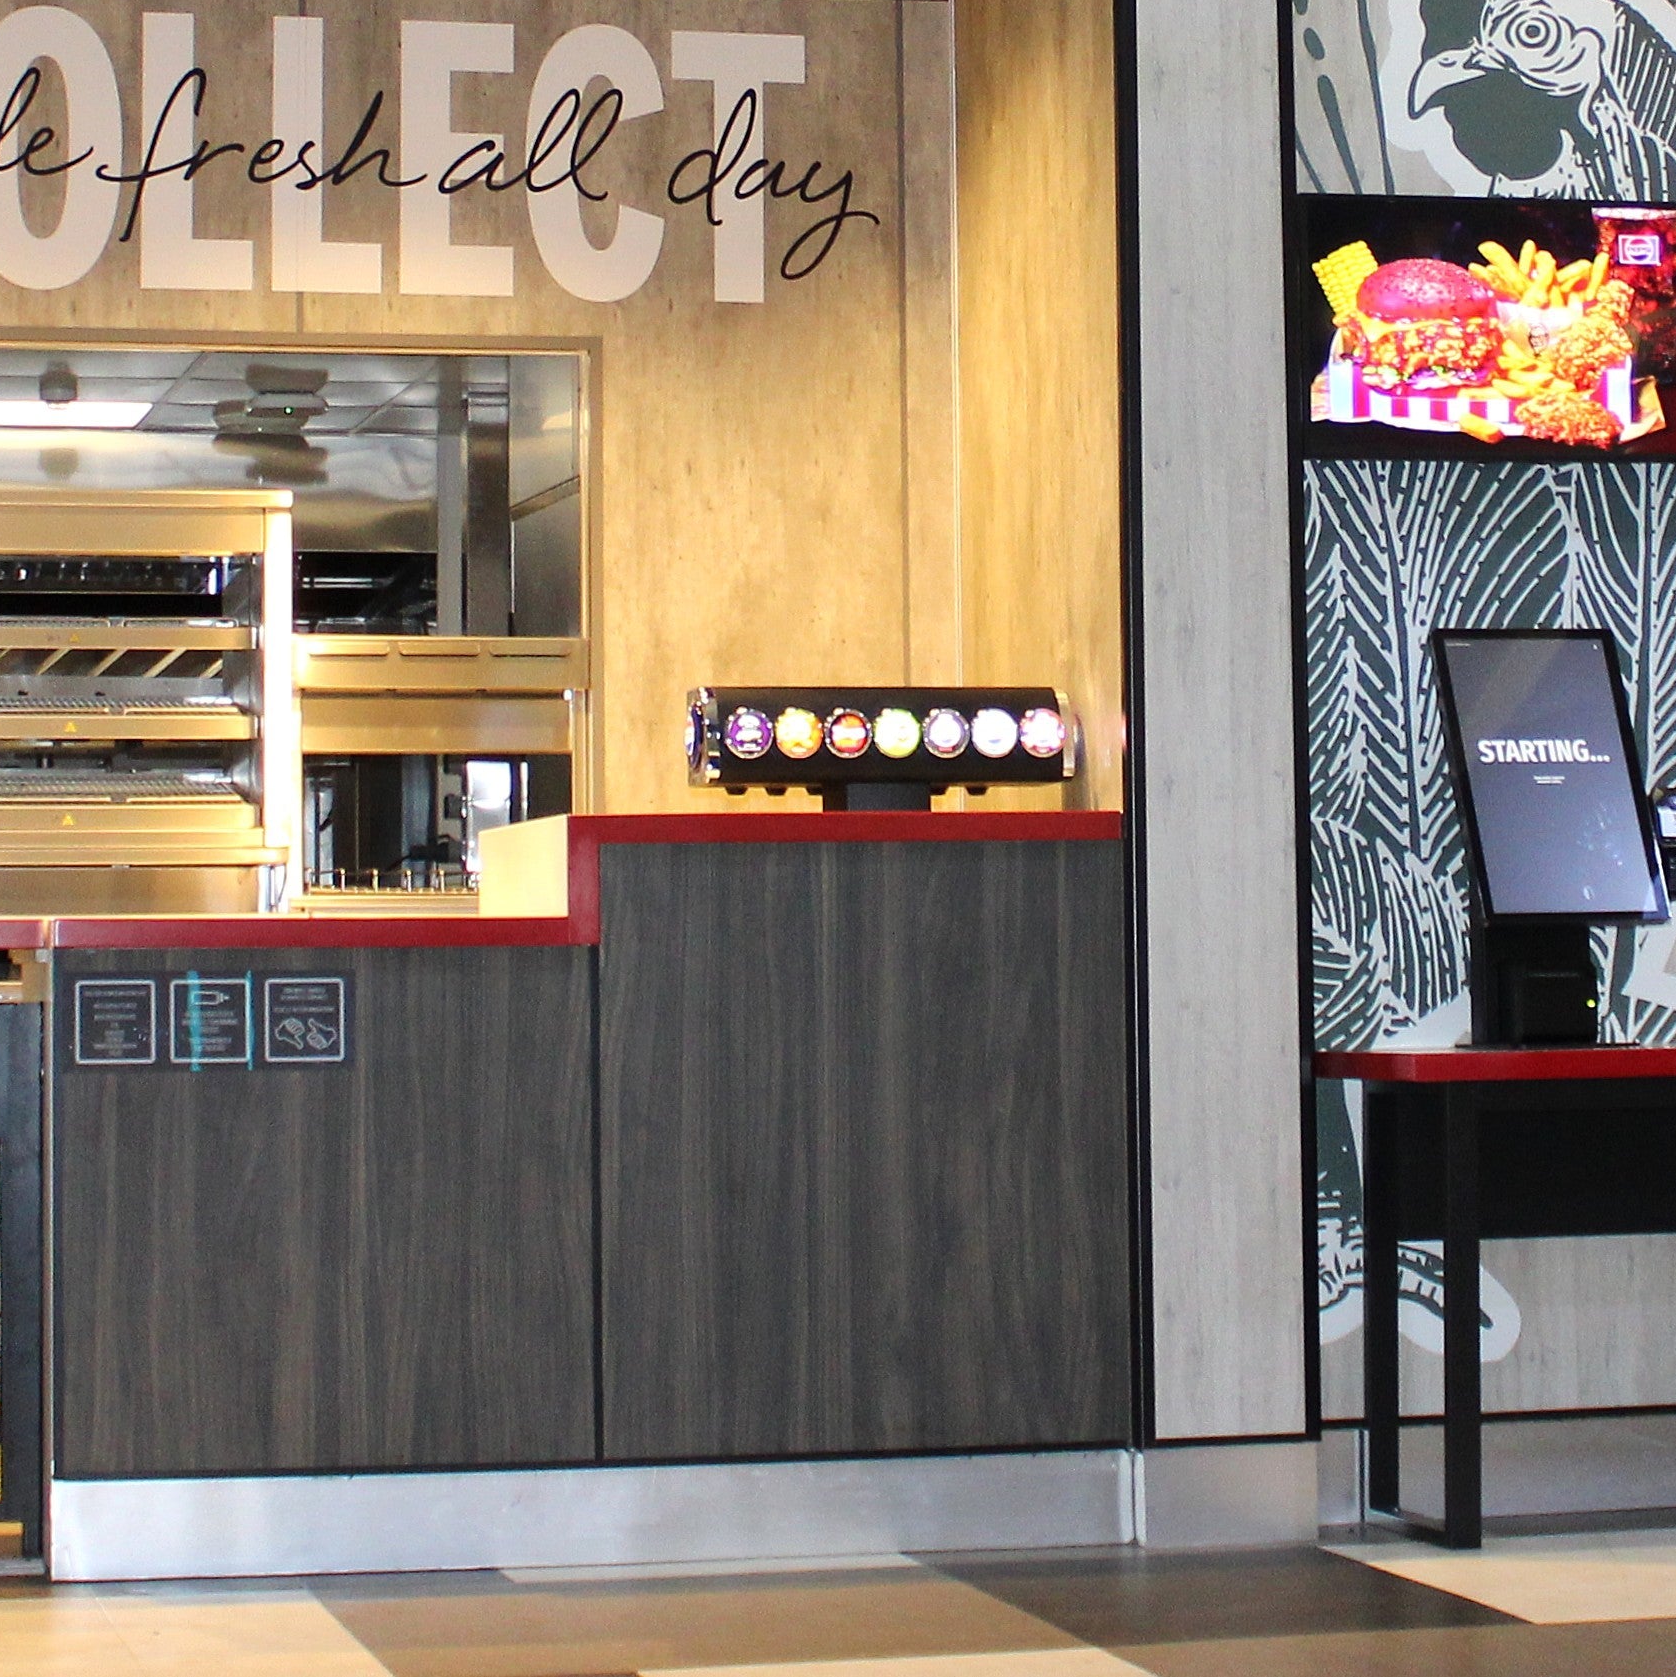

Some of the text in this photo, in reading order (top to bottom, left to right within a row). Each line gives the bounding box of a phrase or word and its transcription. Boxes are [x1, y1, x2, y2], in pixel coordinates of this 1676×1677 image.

[96, 67, 428, 242] fresh
[437, 88, 621, 202] all
[667, 86, 882, 280] day
[1477, 738, 1611, 764] STARTING...
